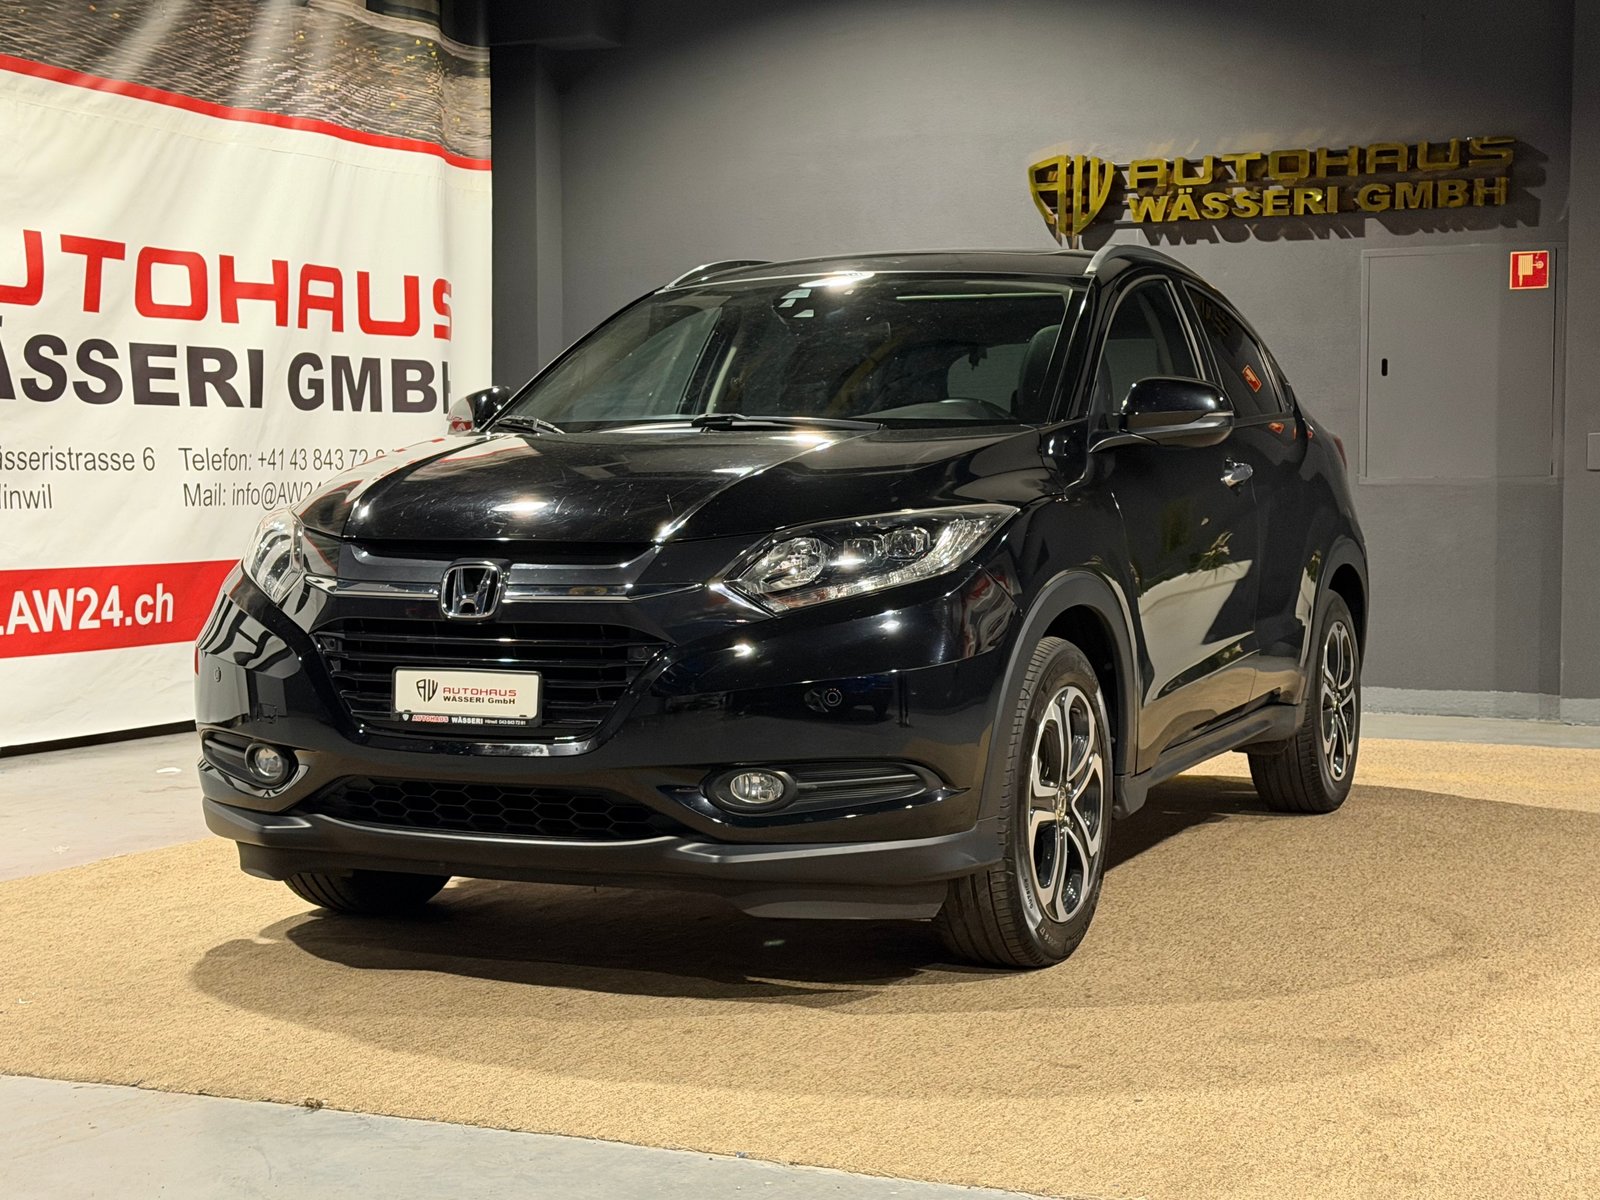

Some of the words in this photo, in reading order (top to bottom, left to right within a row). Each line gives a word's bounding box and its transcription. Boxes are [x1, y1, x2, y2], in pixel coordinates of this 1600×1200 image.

[1128, 136, 1516, 188] AUTOHAUS
[1128, 186, 1339, 223] WÄSSERI
[1357, 177, 1510, 212] GMBH
[0, 446, 136, 471] sseristrasse
[143, 446, 156, 472] 6
[178, 447, 252, 472] Telefon:
[257, 448, 285, 471] +41
[289, 448, 308, 471] 43
[313, 448, 345, 471] 843
[0, 483, 53, 509] inwil
[183, 483, 226, 507] Mail:
[232, 481, 322, 510] info@AW2
[443, 687, 517, 697] AUTOHAUS
[488, 697, 516, 705] GmbH
[412, 714, 449, 723] AUTOHAUS
